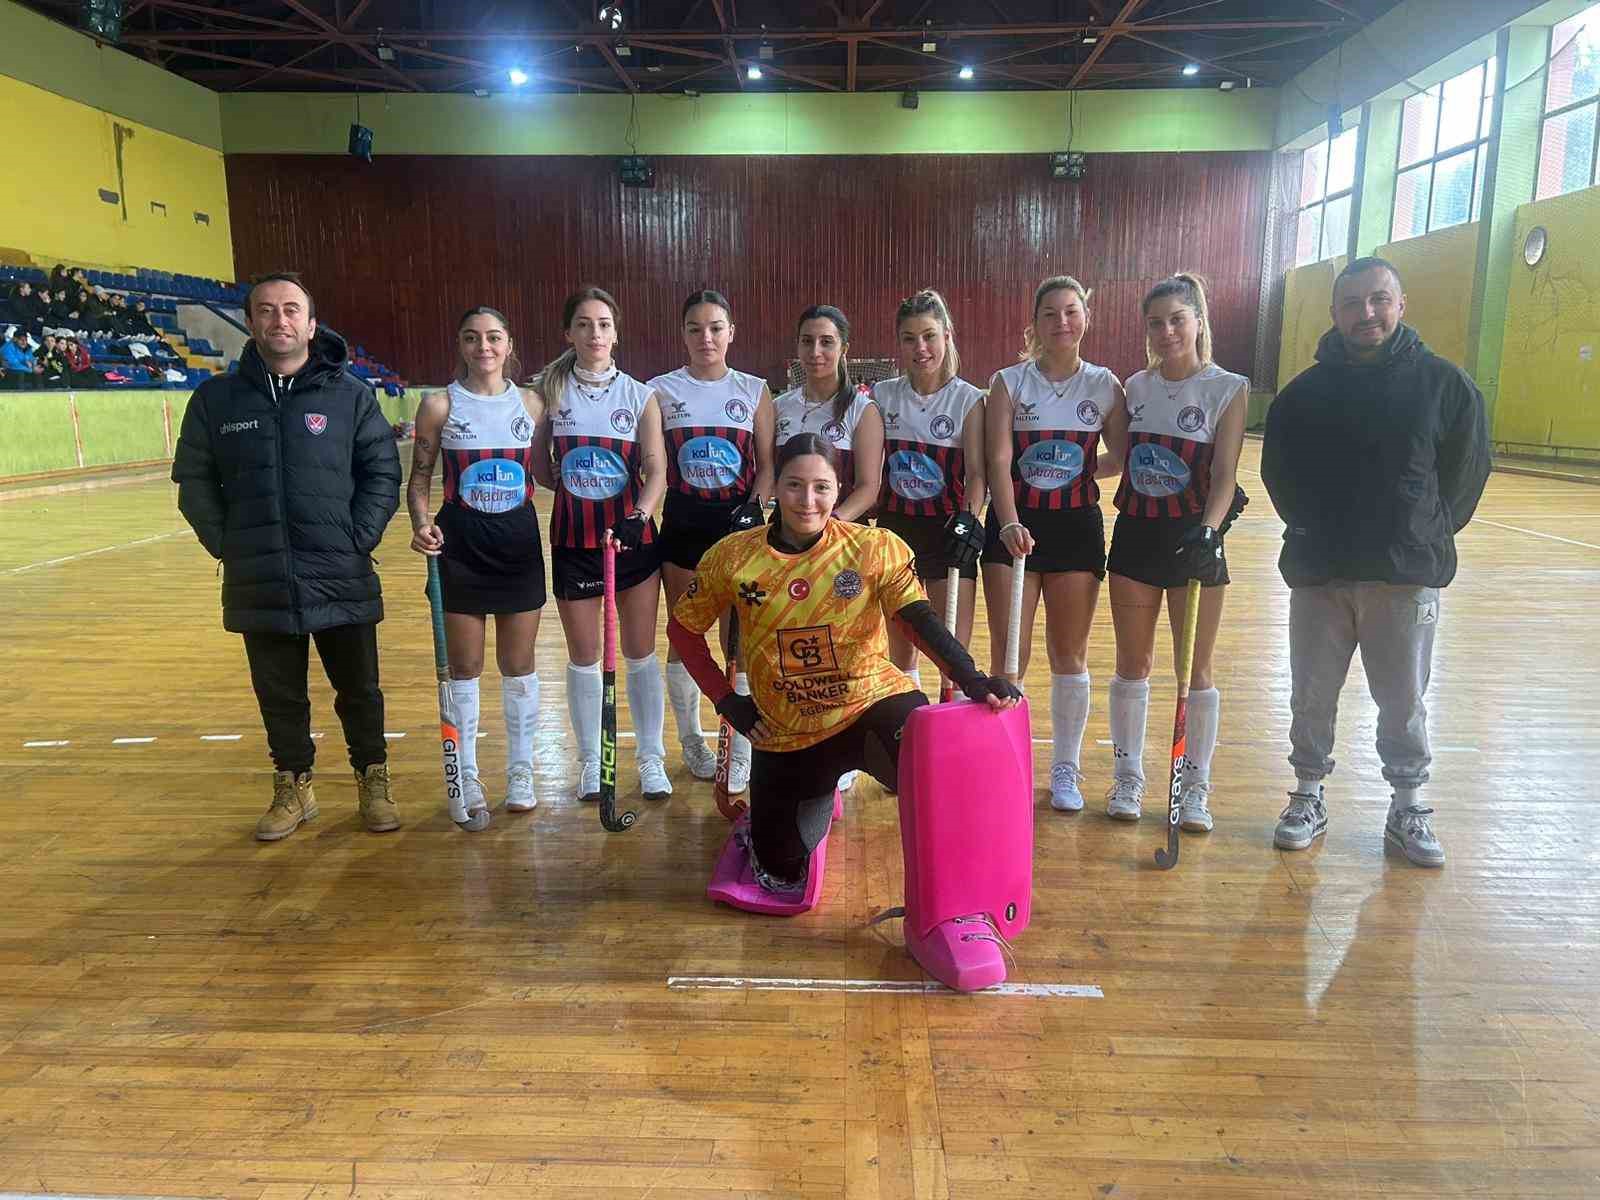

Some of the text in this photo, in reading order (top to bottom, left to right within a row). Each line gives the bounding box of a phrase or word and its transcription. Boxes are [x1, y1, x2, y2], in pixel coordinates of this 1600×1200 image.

[219, 419, 259, 434] uhlsport
[692, 442, 726, 458] kaltun
[575, 452, 610, 468] kaltun
[477, 464, 515, 482] kaltun
[569, 473, 618, 489] Madran
[470, 487, 518, 502] Madran
[786, 682, 849, 703] BANKER
[602, 729, 615, 785] JDH
